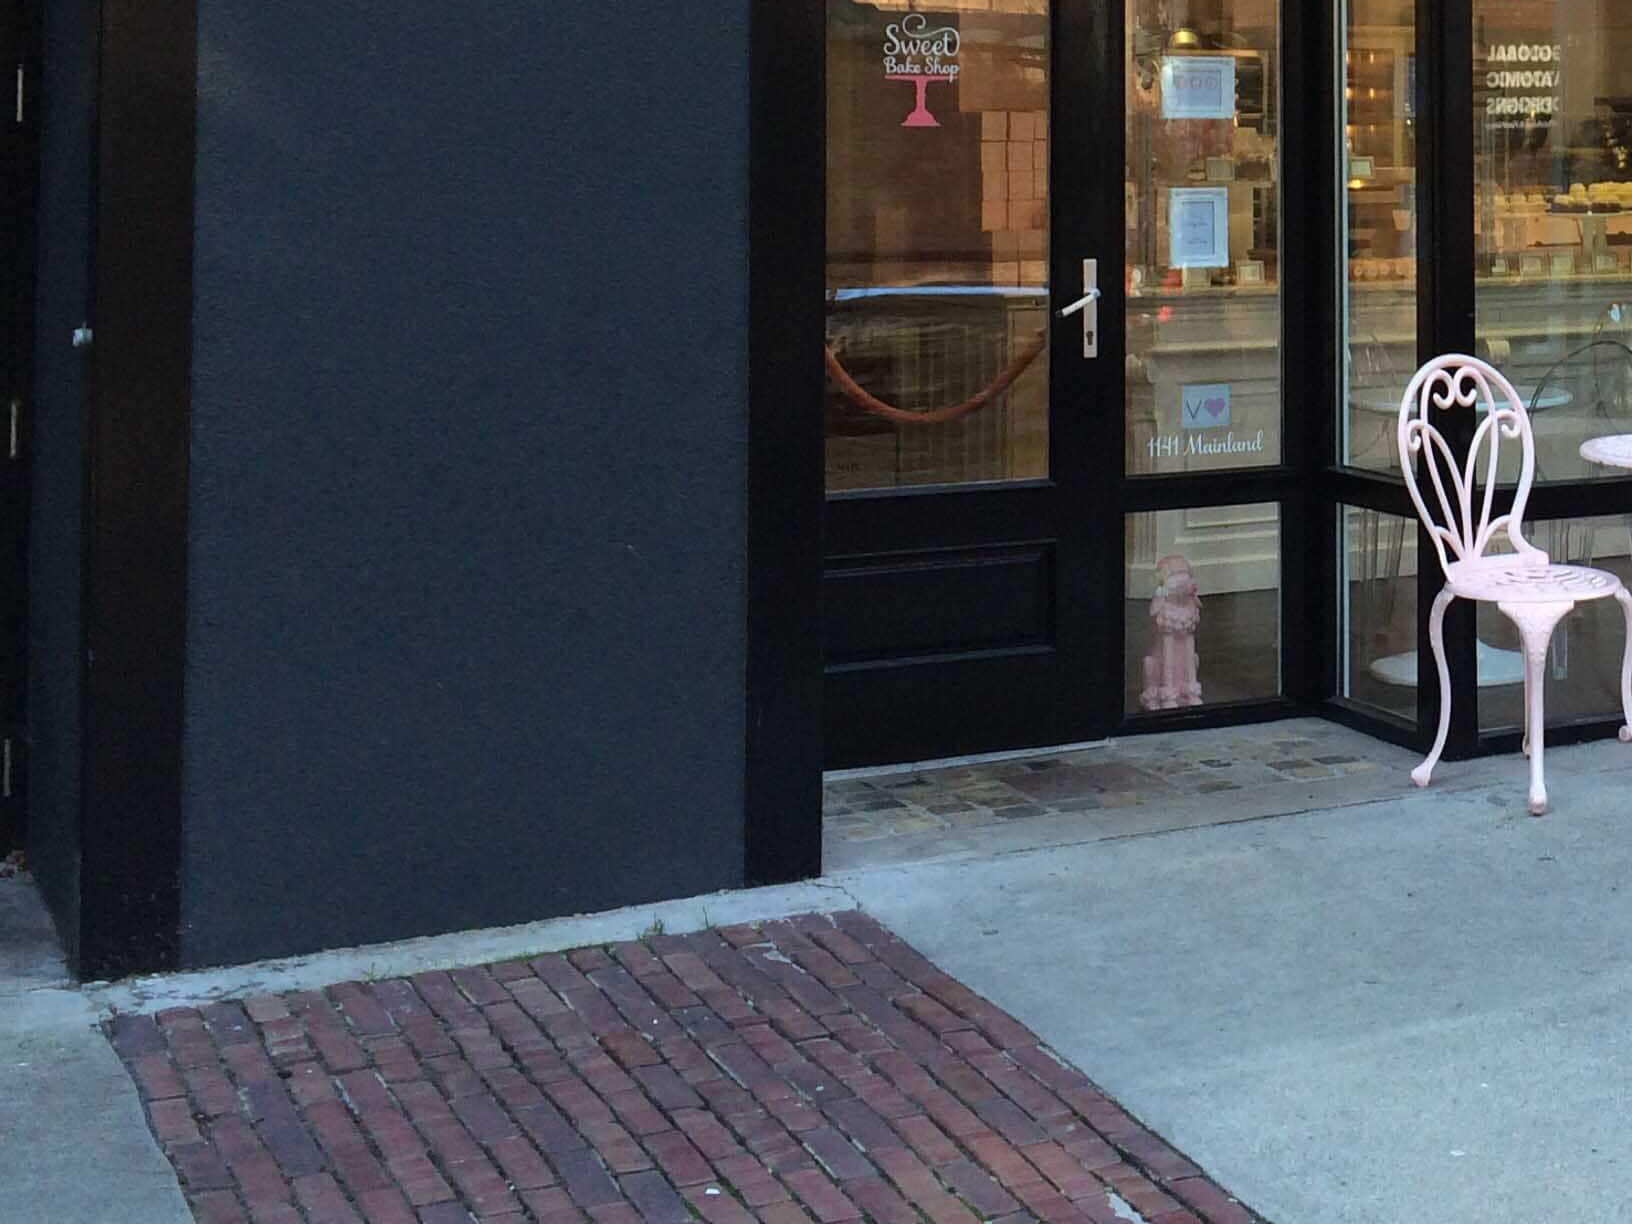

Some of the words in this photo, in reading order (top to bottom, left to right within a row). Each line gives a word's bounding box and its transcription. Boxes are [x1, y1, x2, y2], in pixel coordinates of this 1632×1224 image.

[883, 13, 961, 56] Sweet
[883, 56, 921, 74] Bake
[925, 56, 961, 82] Shop
[1146, 435, 1179, 457] 1141
[1184, 430, 1265, 456] Mainland
